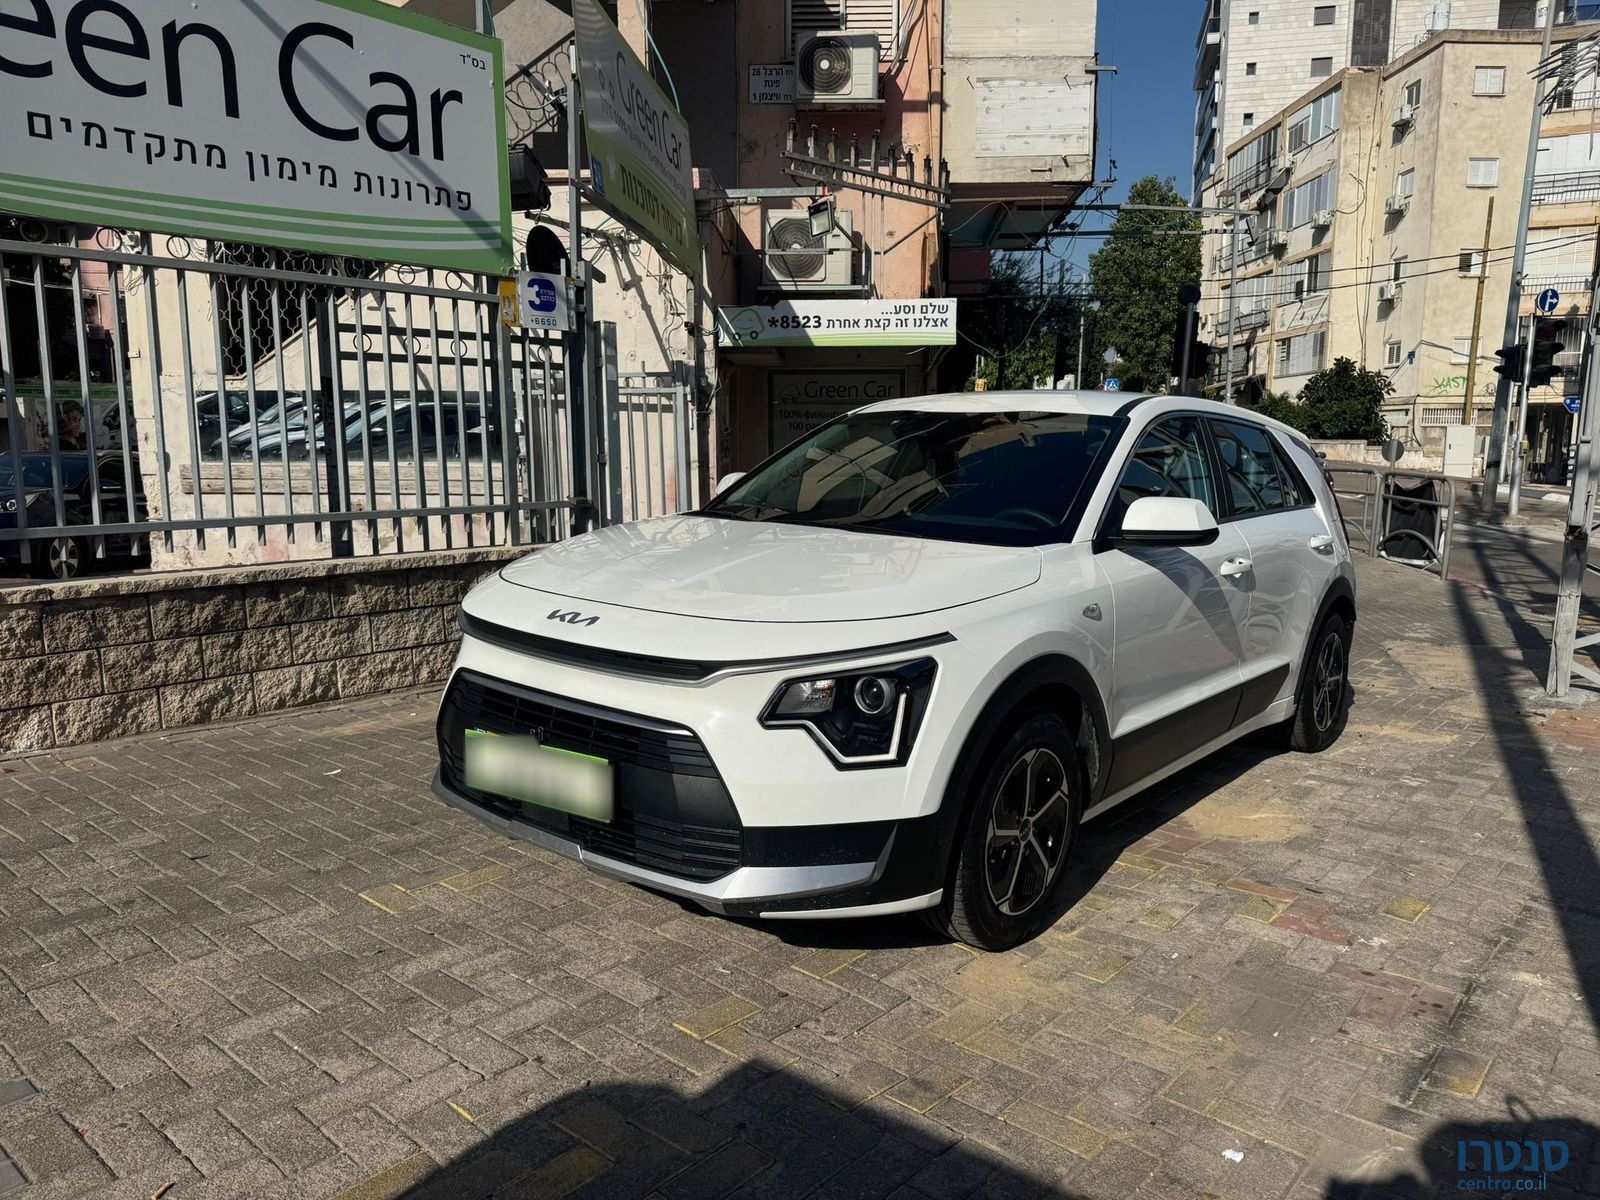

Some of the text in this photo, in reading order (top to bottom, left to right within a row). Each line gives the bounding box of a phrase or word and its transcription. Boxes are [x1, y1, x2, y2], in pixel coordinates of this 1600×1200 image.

[762, 66, 784, 76] הרצל
[763, 79, 781, 88] פינת
[278, 22, 463, 161] Car
[616, 51, 662, 152] Green
[662, 110, 682, 172] Car
[27, 111, 472, 211] פתרונות מימון מתקדמים
[920, 302, 949, 314] שלם
[826, 318, 861, 329] אחרת
[864, 318, 892, 331] קצת
[895, 318, 910, 328] זה
[913, 315, 949, 328] אצלנו
[804, 380, 895, 399] Green Car
[546, 609, 600, 627] KIA
